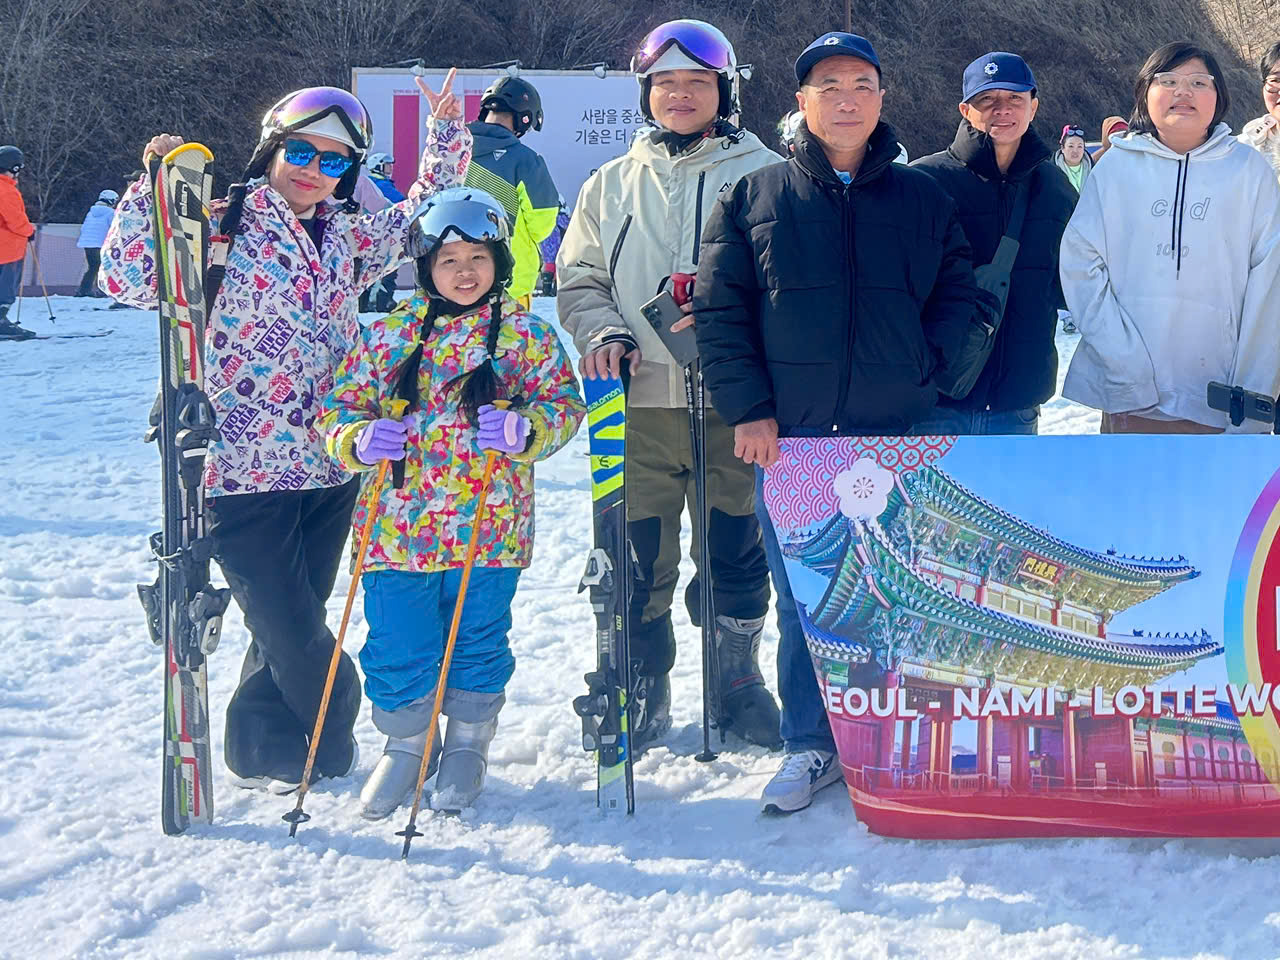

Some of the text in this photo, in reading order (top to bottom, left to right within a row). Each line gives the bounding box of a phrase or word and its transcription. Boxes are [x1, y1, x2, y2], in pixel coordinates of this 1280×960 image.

[581, 109, 618, 125] 사람을
[575, 129, 612, 145] 기술은
[615, 128, 627, 144] 더
[179, 183, 188, 217] elan
[255, 316, 289, 354] WINTER
[264, 322, 295, 360] STORY
[587, 387, 622, 412] salomon
[953, 686, 1055, 716] NAMI
[1093, 683, 1217, 715] LOTTE
